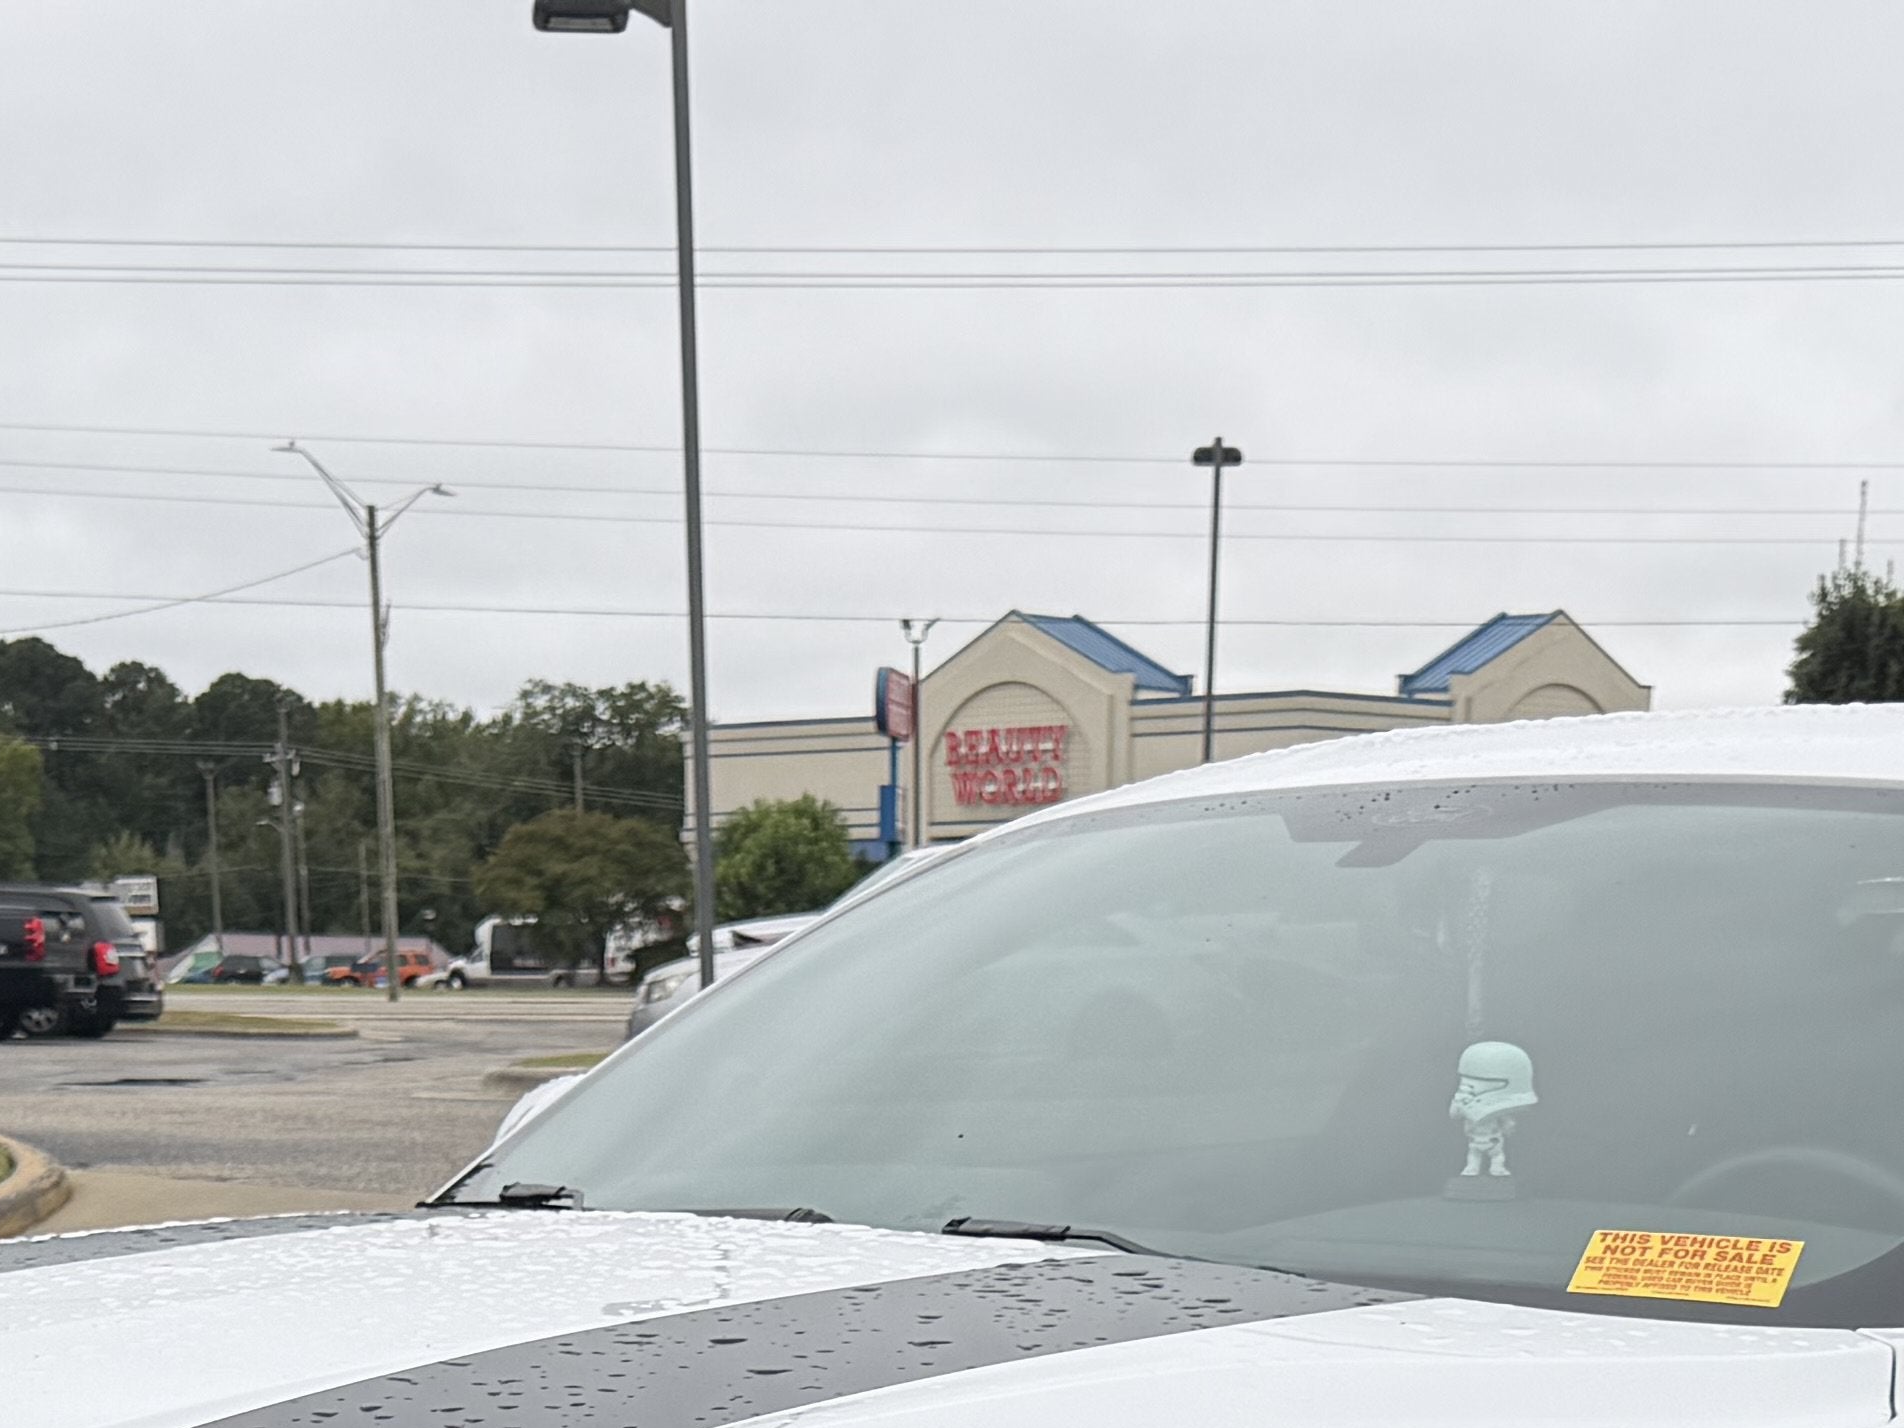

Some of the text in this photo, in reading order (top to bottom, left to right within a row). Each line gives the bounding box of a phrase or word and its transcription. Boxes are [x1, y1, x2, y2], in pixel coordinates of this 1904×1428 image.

[945, 725, 1067, 766] BEAUTY
[951, 767, 1062, 806] WORLD
[1599, 1232, 1792, 1254] THIS VEHICLE IS
[1602, 1244, 1776, 1265] NOT FOR SALE
[1584, 1256, 1785, 1276] SEE THE DEALER FOR RELEASE DATE
